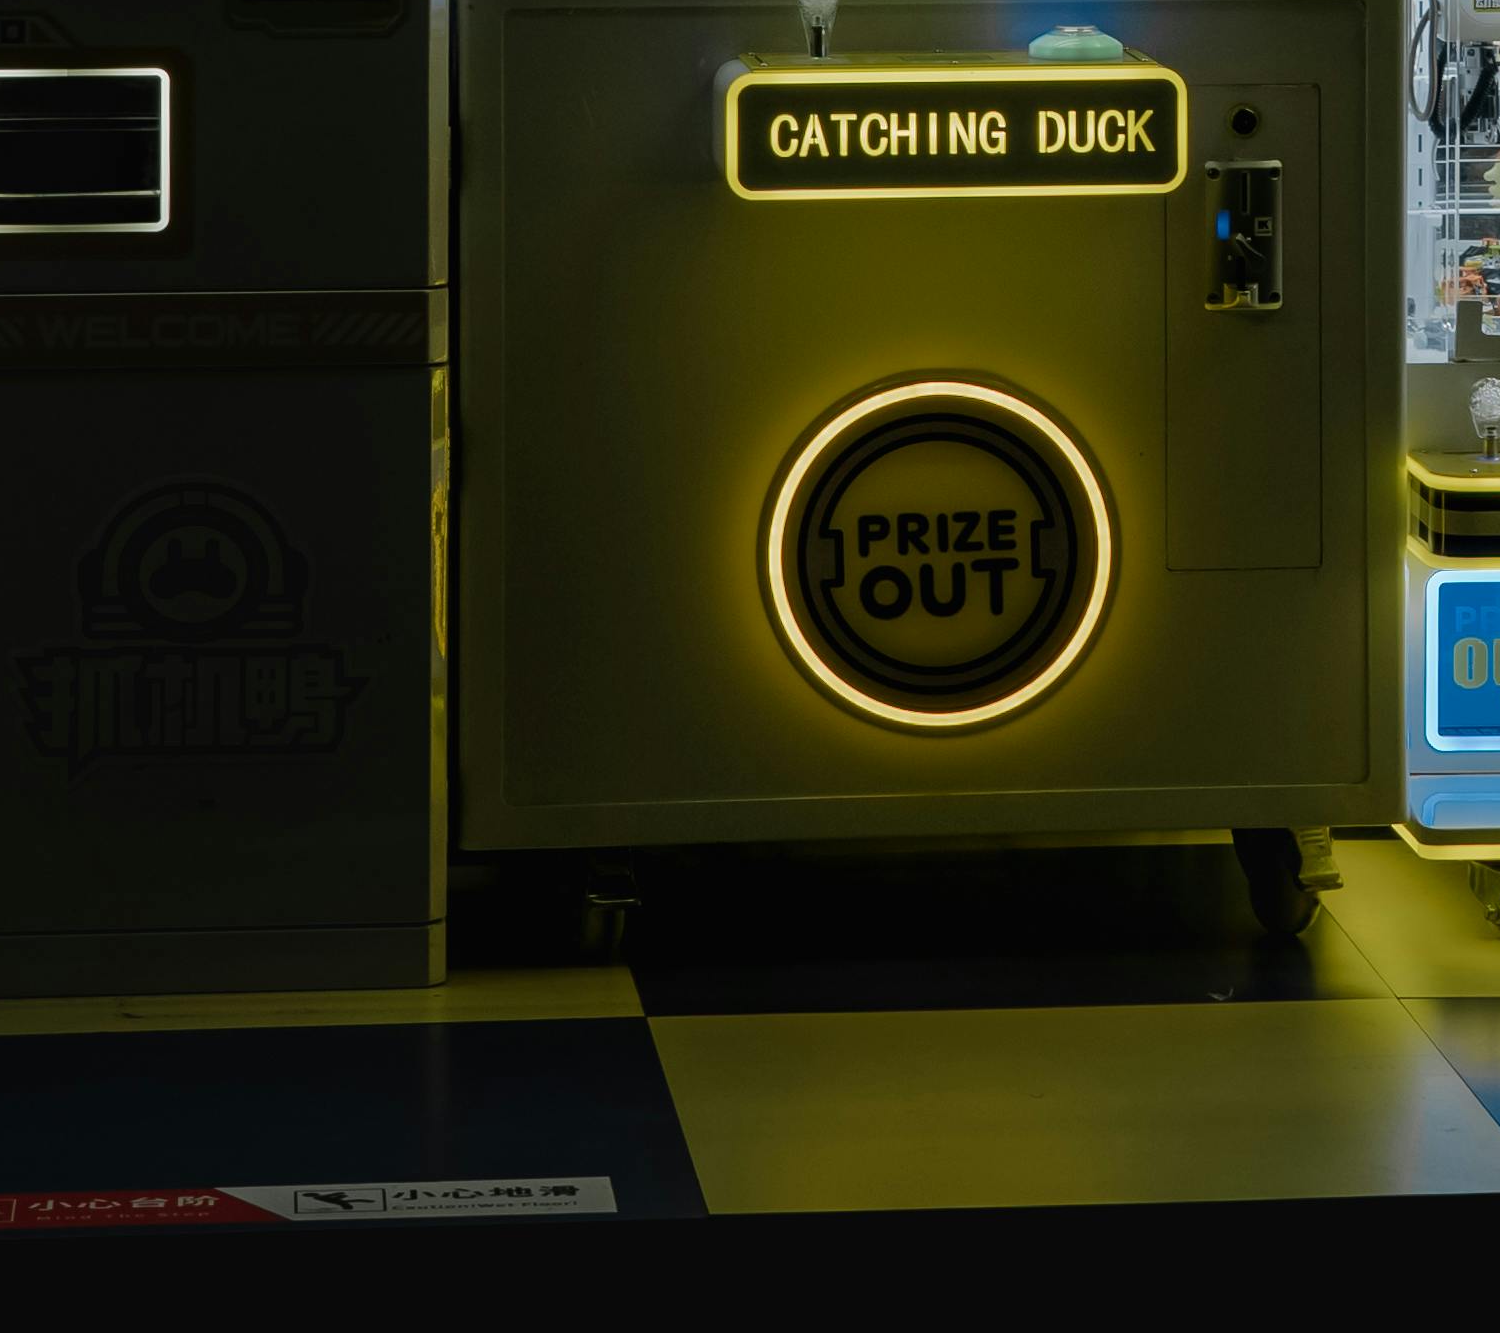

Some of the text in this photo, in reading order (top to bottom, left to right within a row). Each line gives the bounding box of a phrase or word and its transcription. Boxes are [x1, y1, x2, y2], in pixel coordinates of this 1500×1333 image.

[770, 108, 1156, 159] CATCHING DUCK
[40, 311, 300, 349] WELCOME
[858, 508, 1017, 557] PRIZE
[858, 557, 1020, 619] OUT
[27, 1194, 221, 1212] 小心台阶
[391, 1184, 581, 1202] 小心地滑
